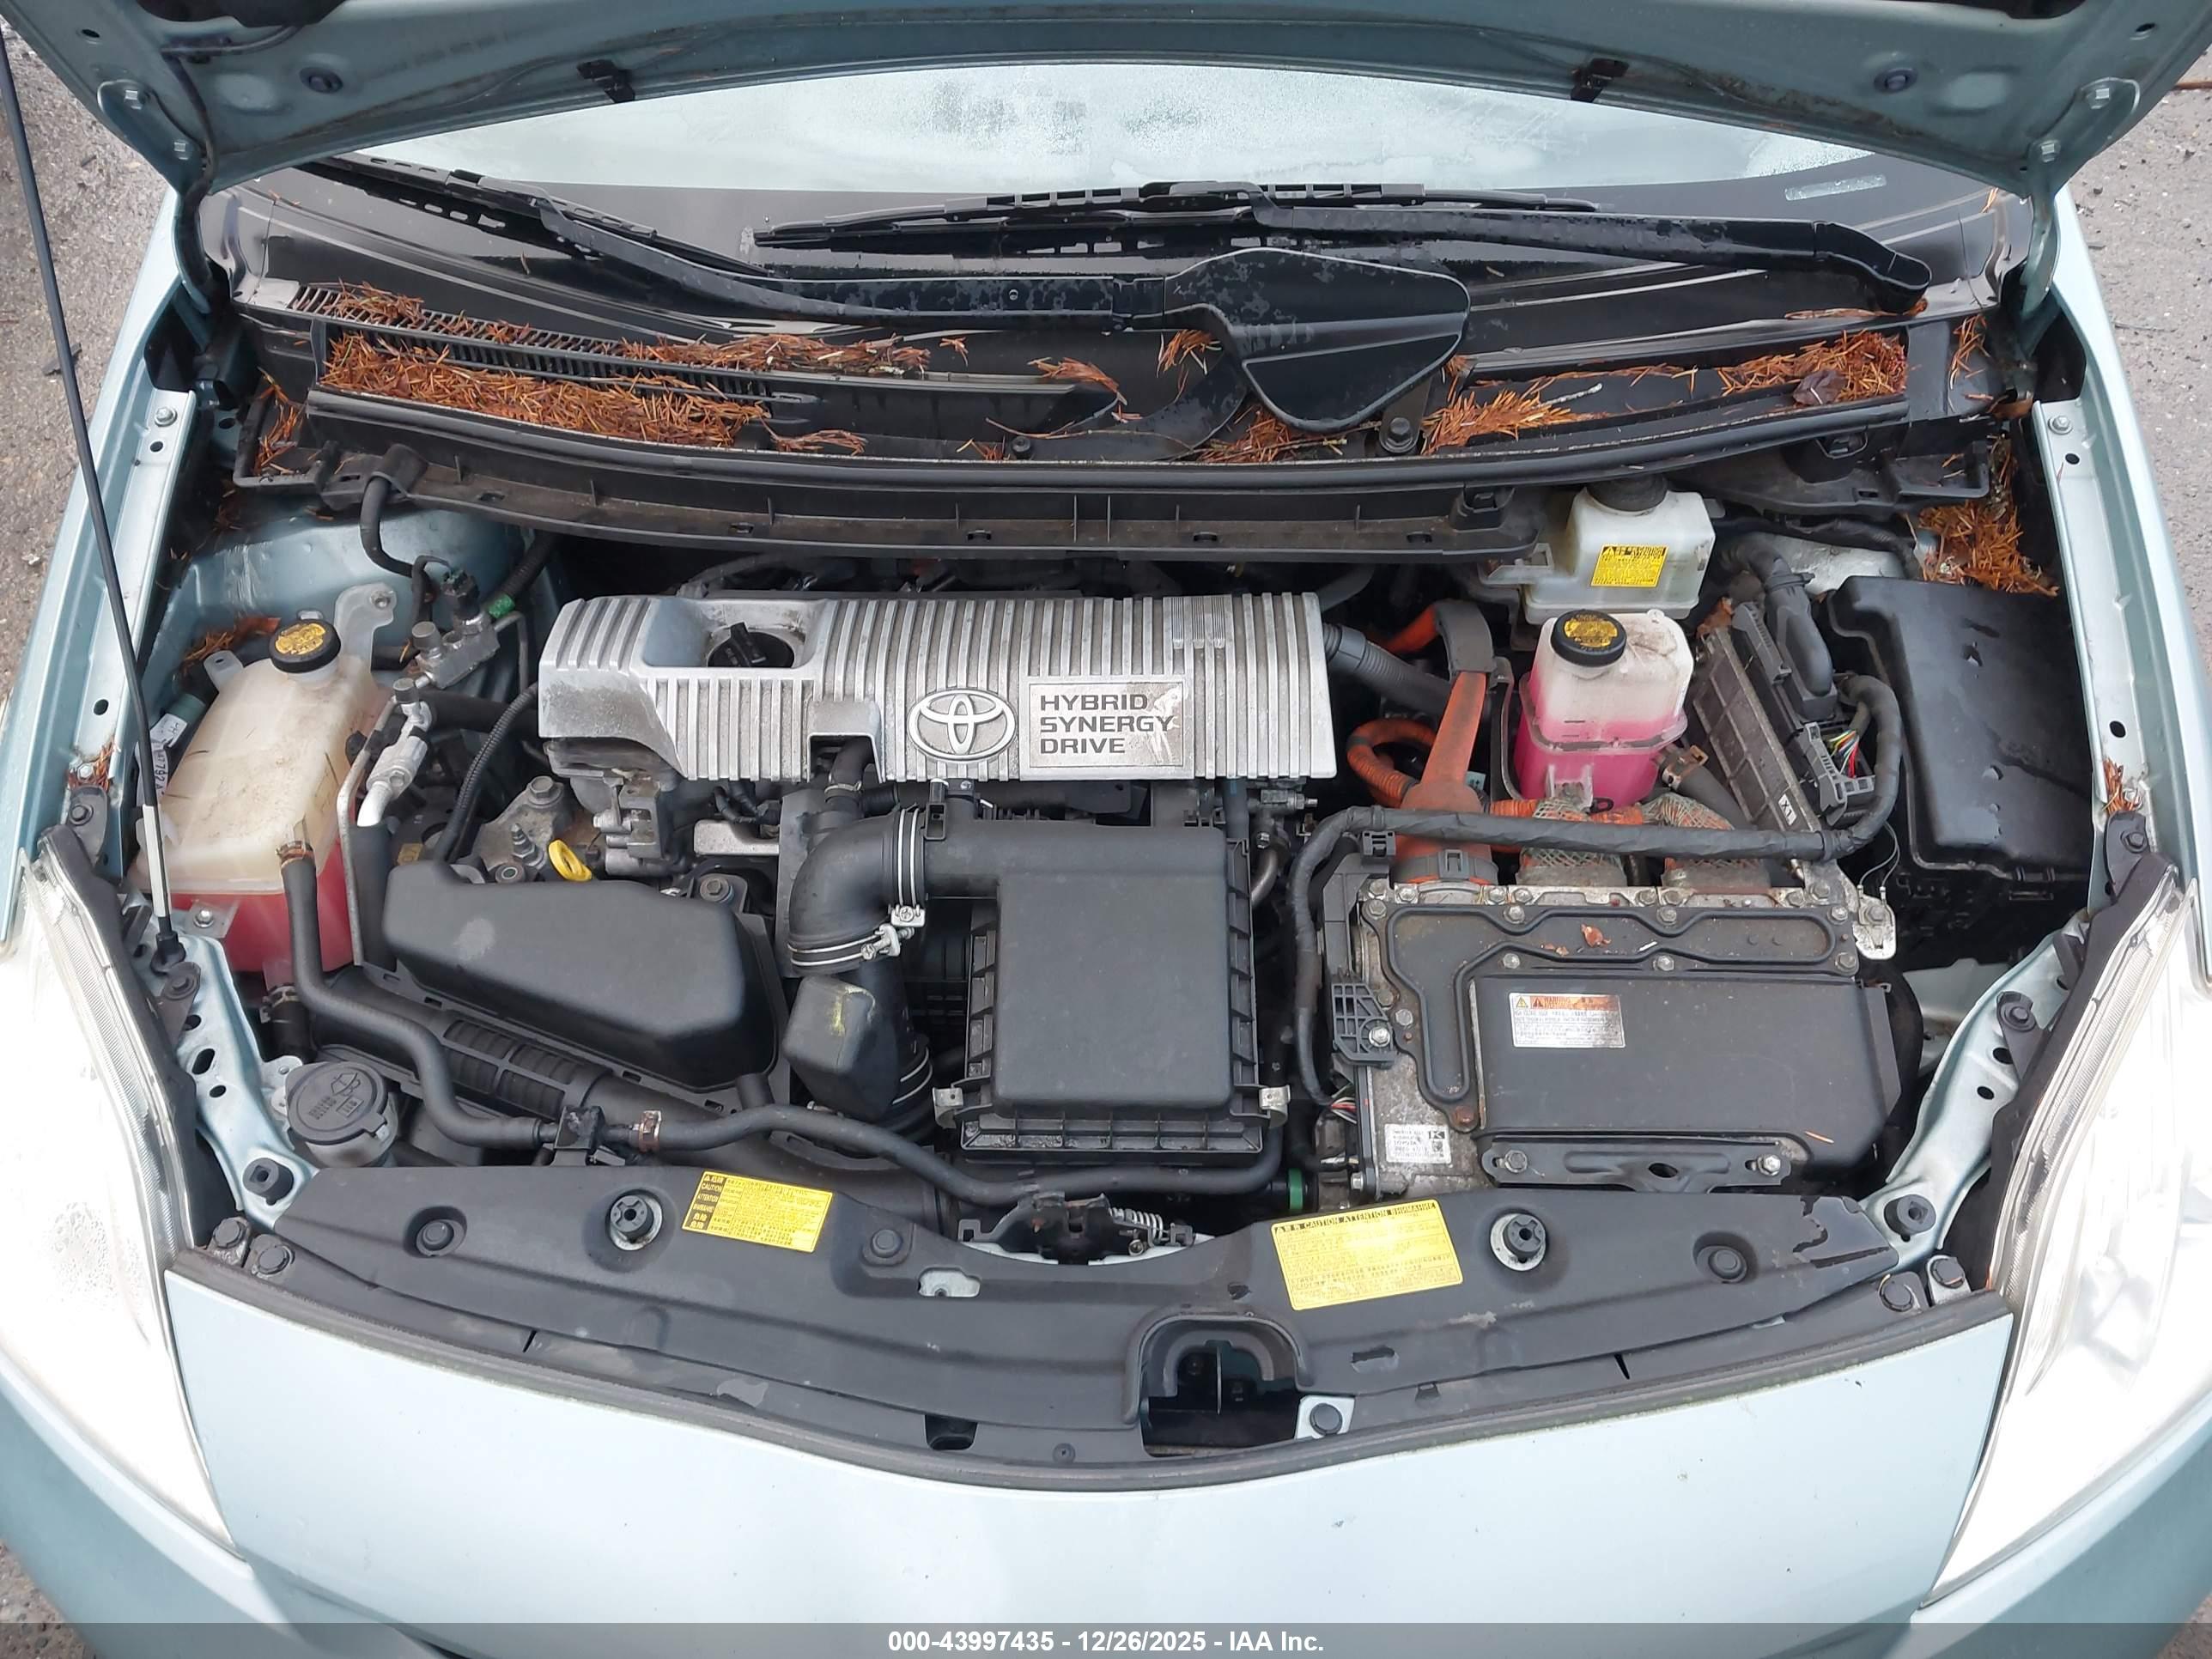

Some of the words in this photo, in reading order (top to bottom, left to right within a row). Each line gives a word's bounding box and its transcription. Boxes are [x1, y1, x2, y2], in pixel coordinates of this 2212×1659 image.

[1040, 694, 1148, 710] HYBRID
[1040, 716, 1173, 732] SYNERGY
[1040, 738, 1126, 754] DRIVE
[702, 1182, 722, 1192] CAUTION
[1305, 1217, 1340, 1228] CAUTION
[1343, 1210, 1387, 1222] ATTENTION
